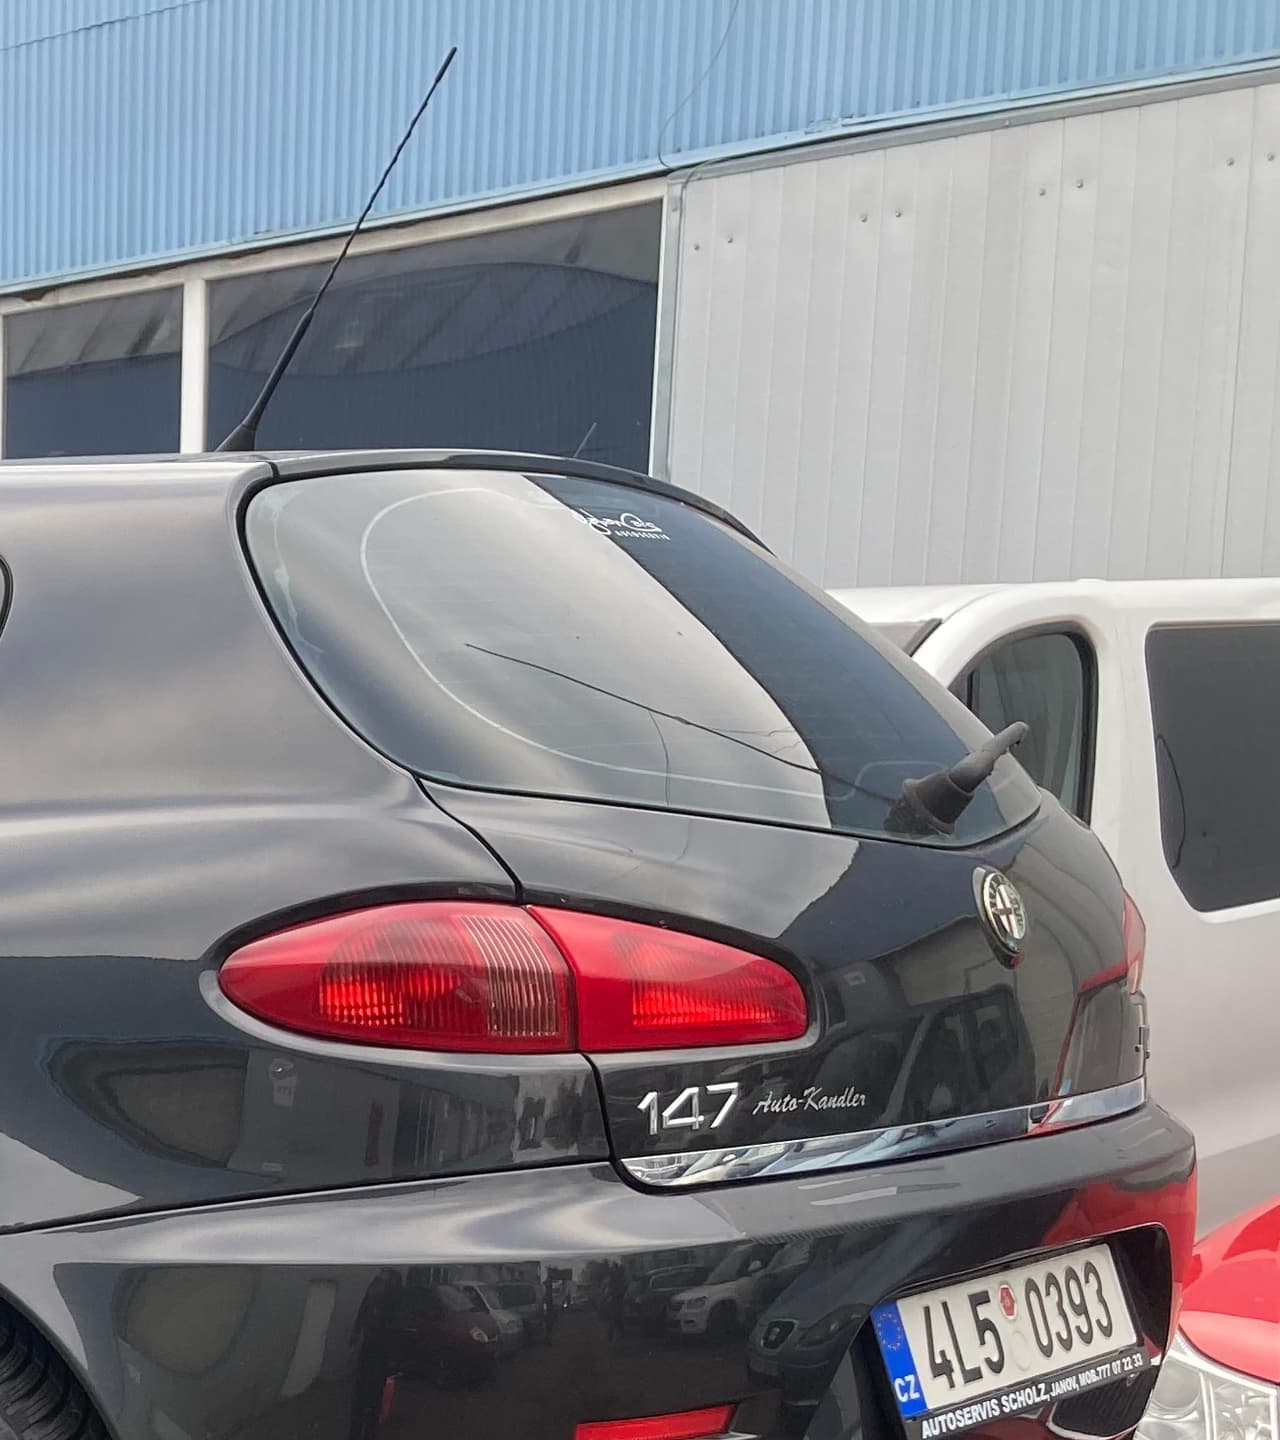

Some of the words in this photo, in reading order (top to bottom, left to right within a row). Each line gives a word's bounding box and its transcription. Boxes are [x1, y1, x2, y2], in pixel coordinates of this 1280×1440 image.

[637, 1082, 739, 1135] 147
[923, 1290, 1005, 1389] 4L5
[1024, 1260, 1113, 1358] 0393
[894, 1377, 921, 1402] CZ
[921, 1399, 1000, 1439] AUTOSERVIS
[1002, 1383, 1051, 1414] SCHOLZ,
[1111, 1360, 1122, 1375] 07
